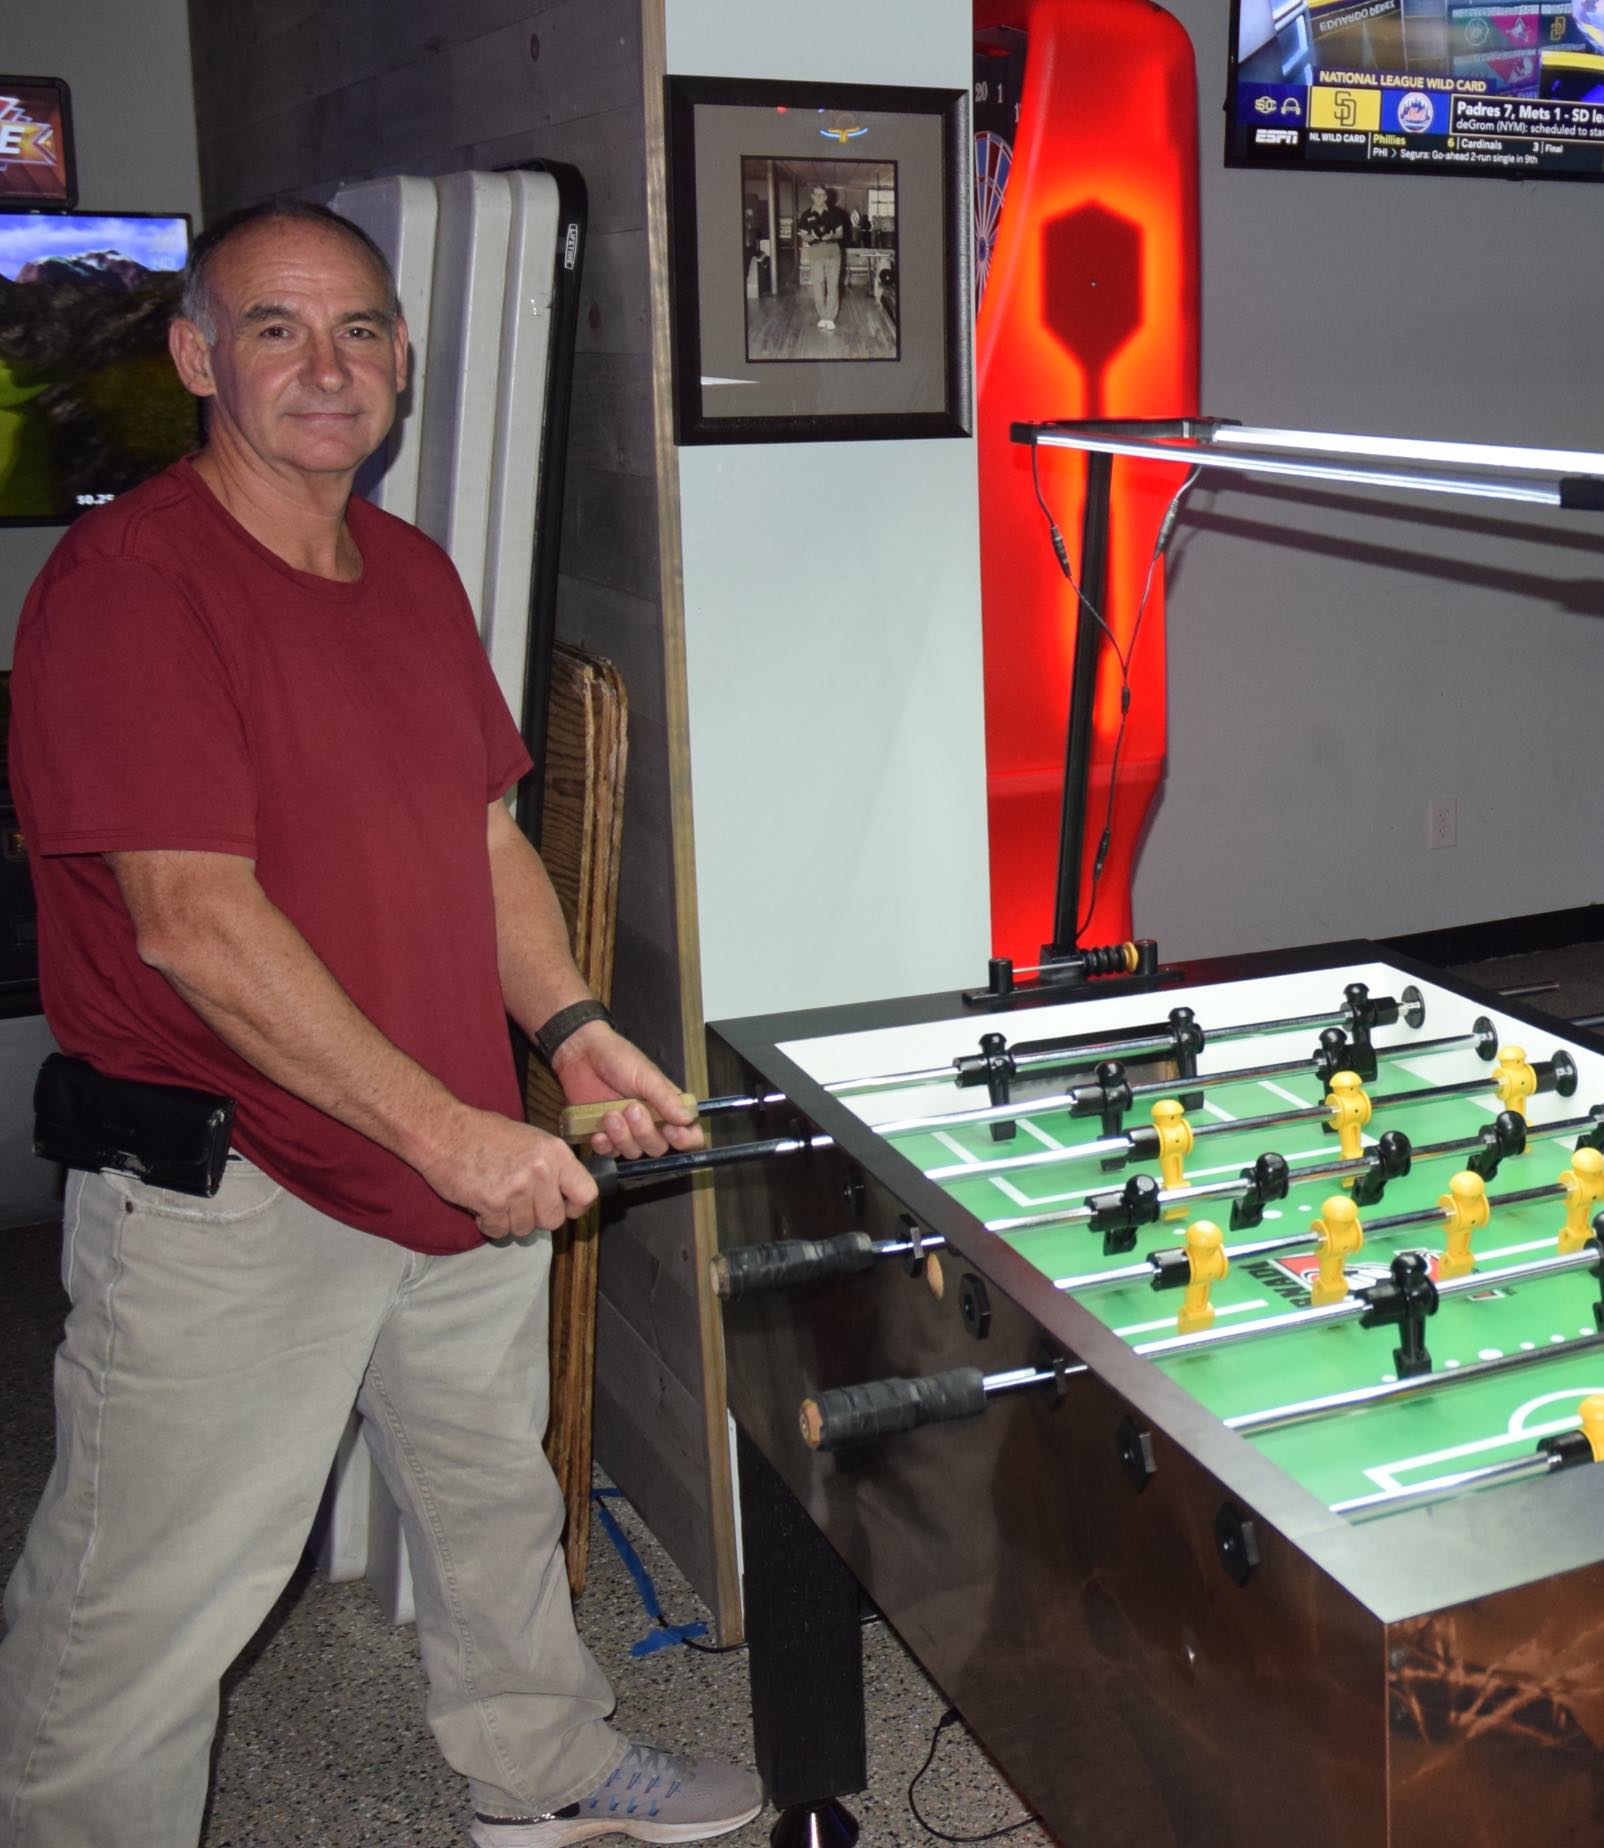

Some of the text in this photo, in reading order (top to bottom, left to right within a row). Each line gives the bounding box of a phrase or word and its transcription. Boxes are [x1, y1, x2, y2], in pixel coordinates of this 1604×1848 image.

[1320, 71, 1487, 92] NATIONAL LEAGUE WILD CARD
[975, 80, 988, 102] 20
[998, 83, 1004, 104] 1
[1457, 101, 1501, 118] Padres
[1503, 104, 1516, 119] 7,
[1519, 105, 1551, 120] Mets
[1553, 107, 1561, 120] 1
[1572, 108, 1589, 122] SD
[1456, 118, 1495, 131] deGrom
[1496, 120, 1528, 134] (NYM):
[1530, 122, 1576, 136] scheduled
[1578, 126, 1587, 136] to
[1255, 128, 1299, 145] ESPN
[1309, 132, 1366, 143] NL WILD CARD
[1373, 133, 1455, 149] Phillies 6
[1461, 137, 1540, 152] Cardinals 3
[1373, 148, 1387, 157] PHI
[1545, 144, 1564, 153] Final
[1400, 150, 1538, 165] Segura: Go-ahead 2-run single in 9th
